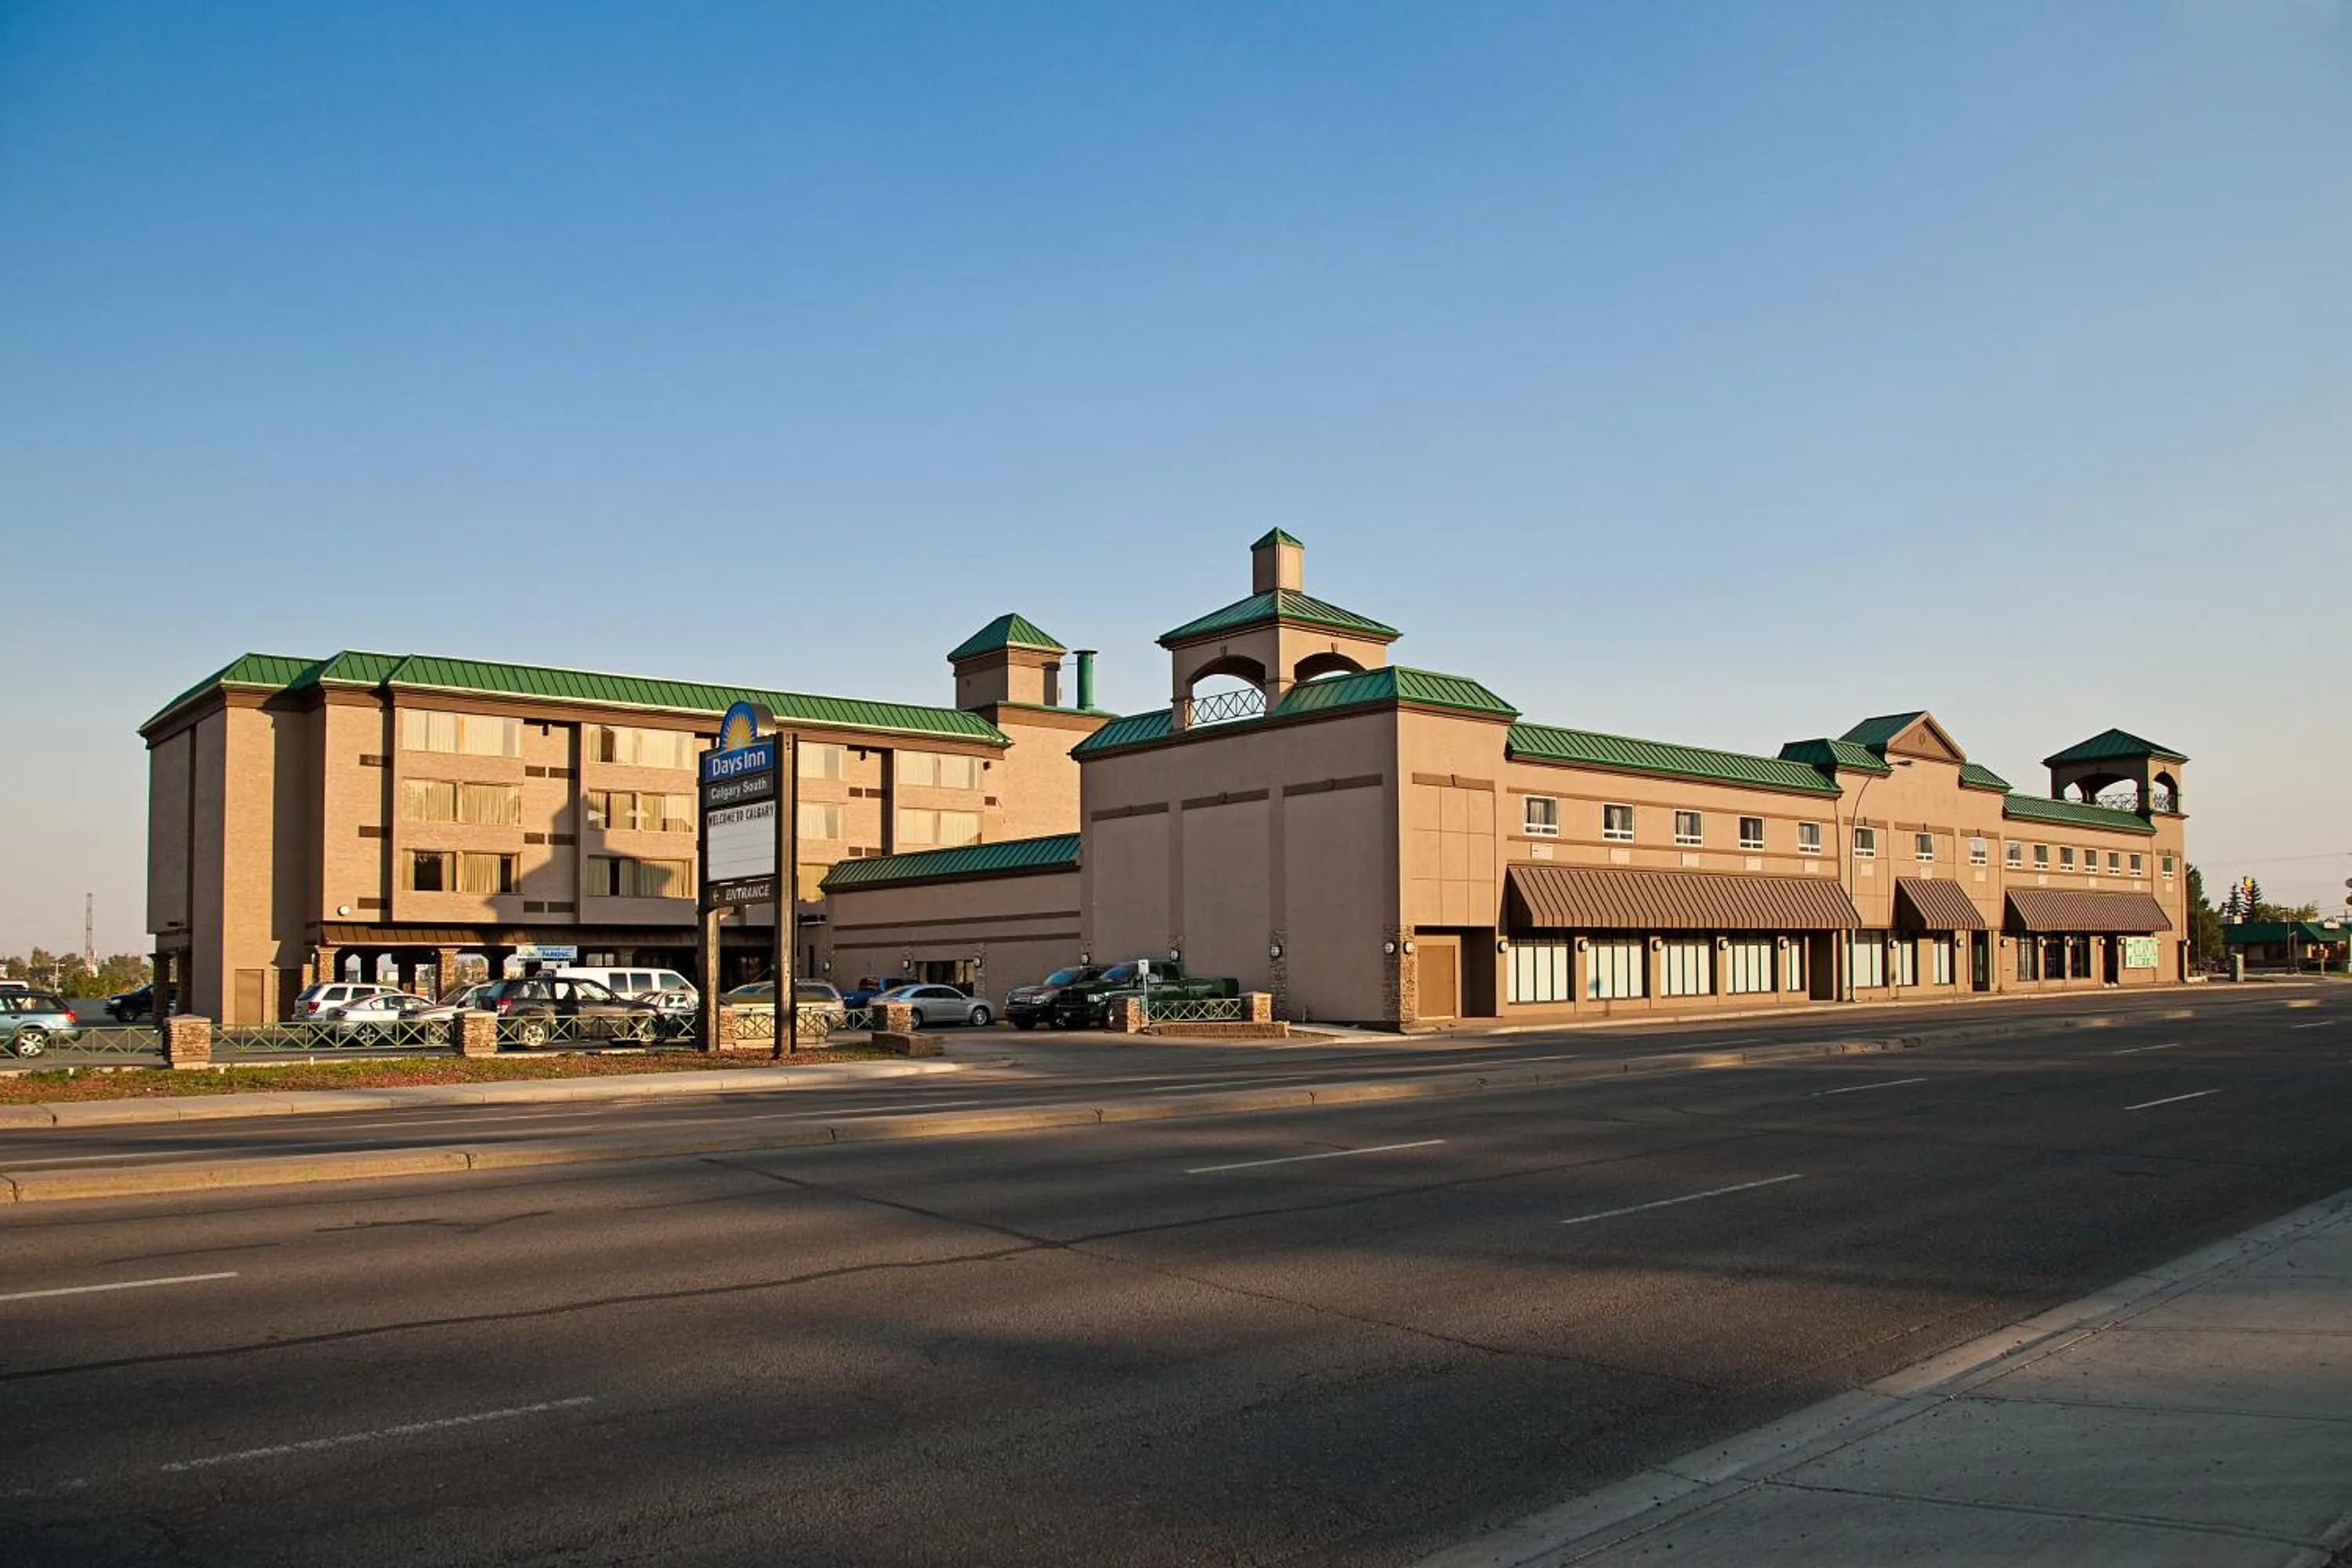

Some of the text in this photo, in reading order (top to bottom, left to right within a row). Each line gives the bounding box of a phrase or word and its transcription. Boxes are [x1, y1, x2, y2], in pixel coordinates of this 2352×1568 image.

[713, 750, 766, 776] Days Inn
[711, 778, 768, 800] Calgary South
[725, 884, 770, 901] ENTRANCE
